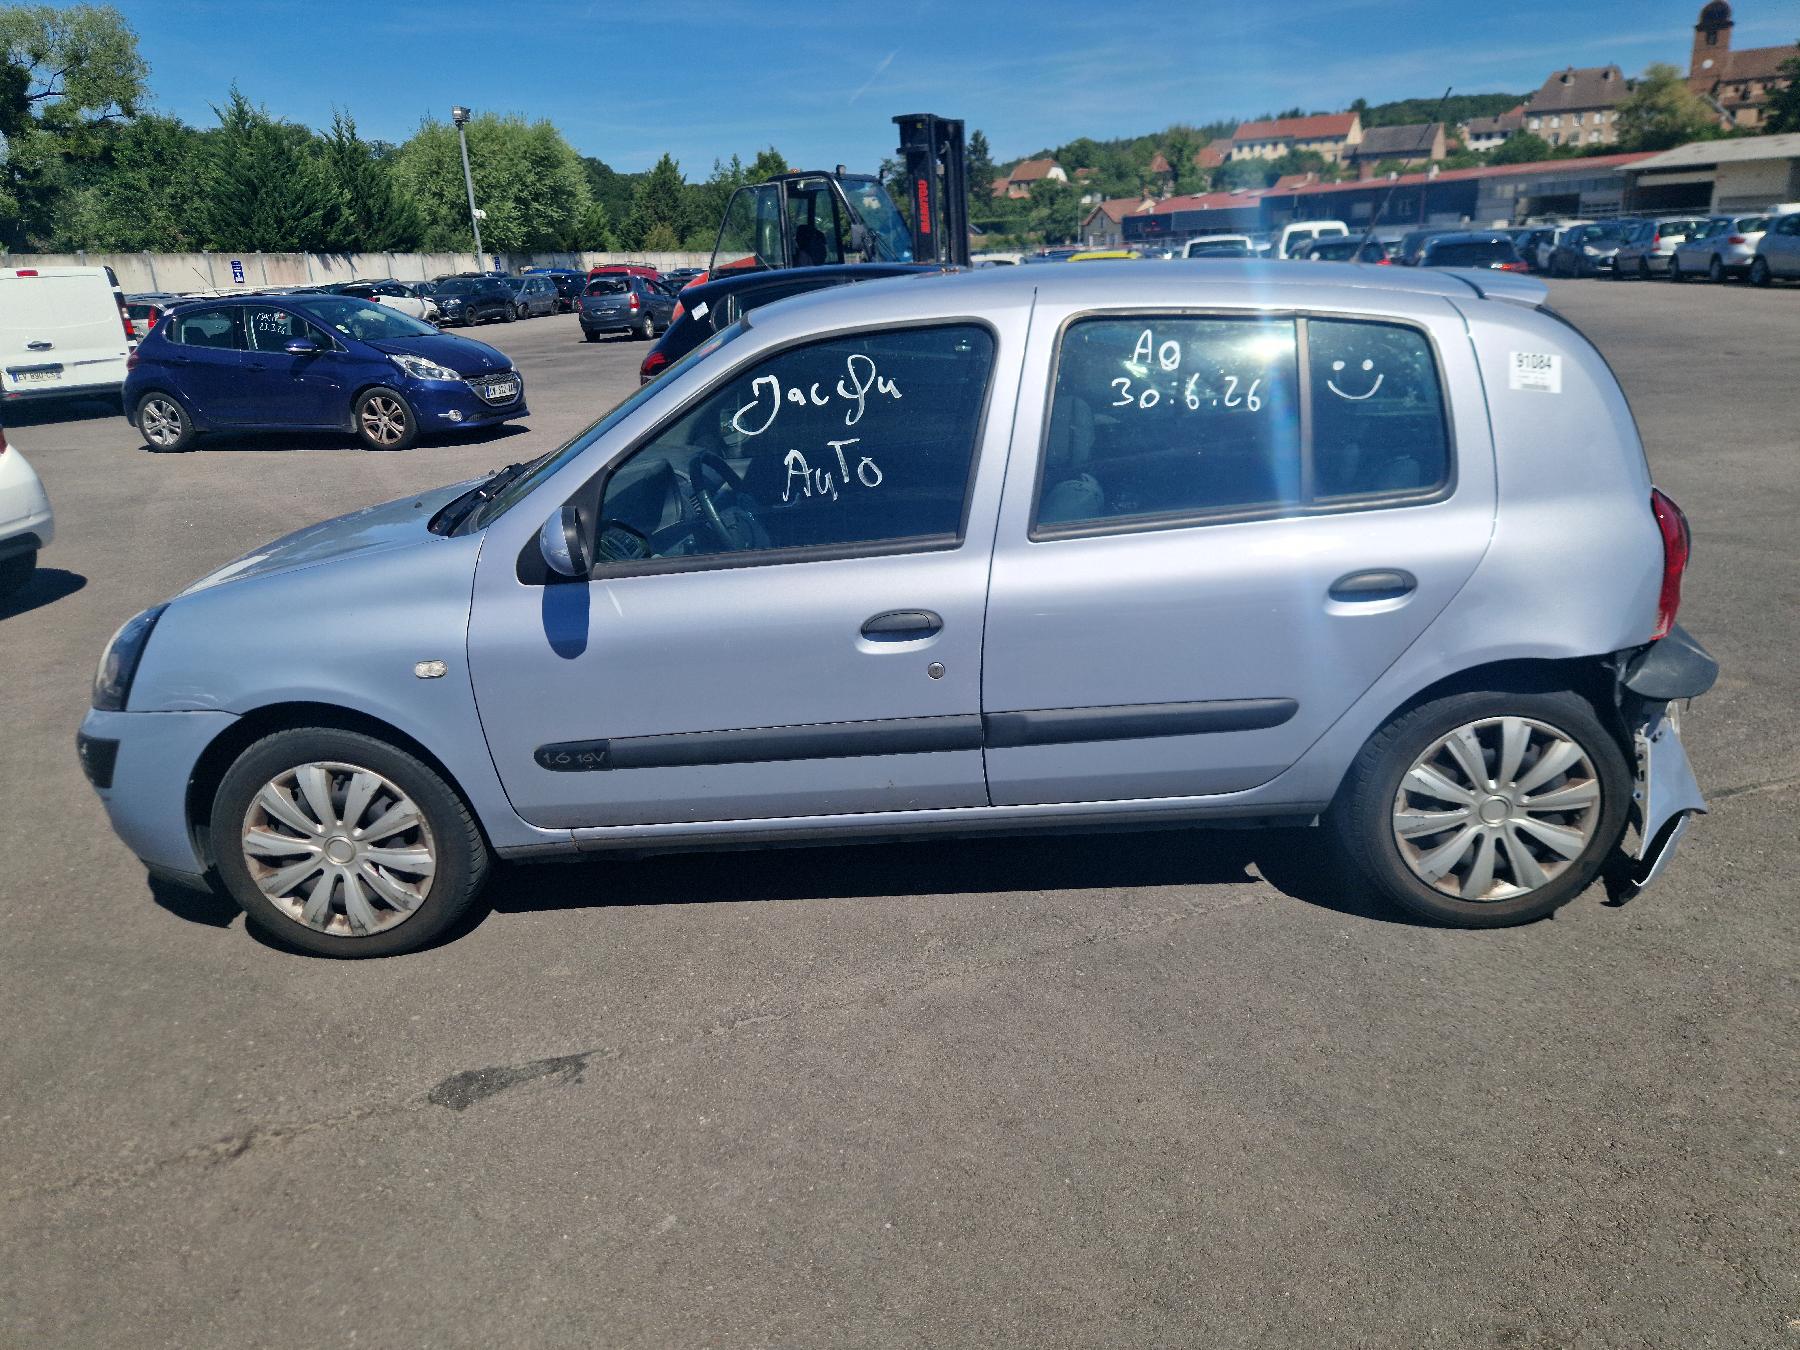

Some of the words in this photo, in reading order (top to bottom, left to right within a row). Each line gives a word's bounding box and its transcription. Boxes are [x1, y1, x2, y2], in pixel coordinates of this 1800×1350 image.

[1517, 352, 1552, 369] 91084
[543, 752, 571, 764] 1.6
[577, 751, 606, 763] 16V
